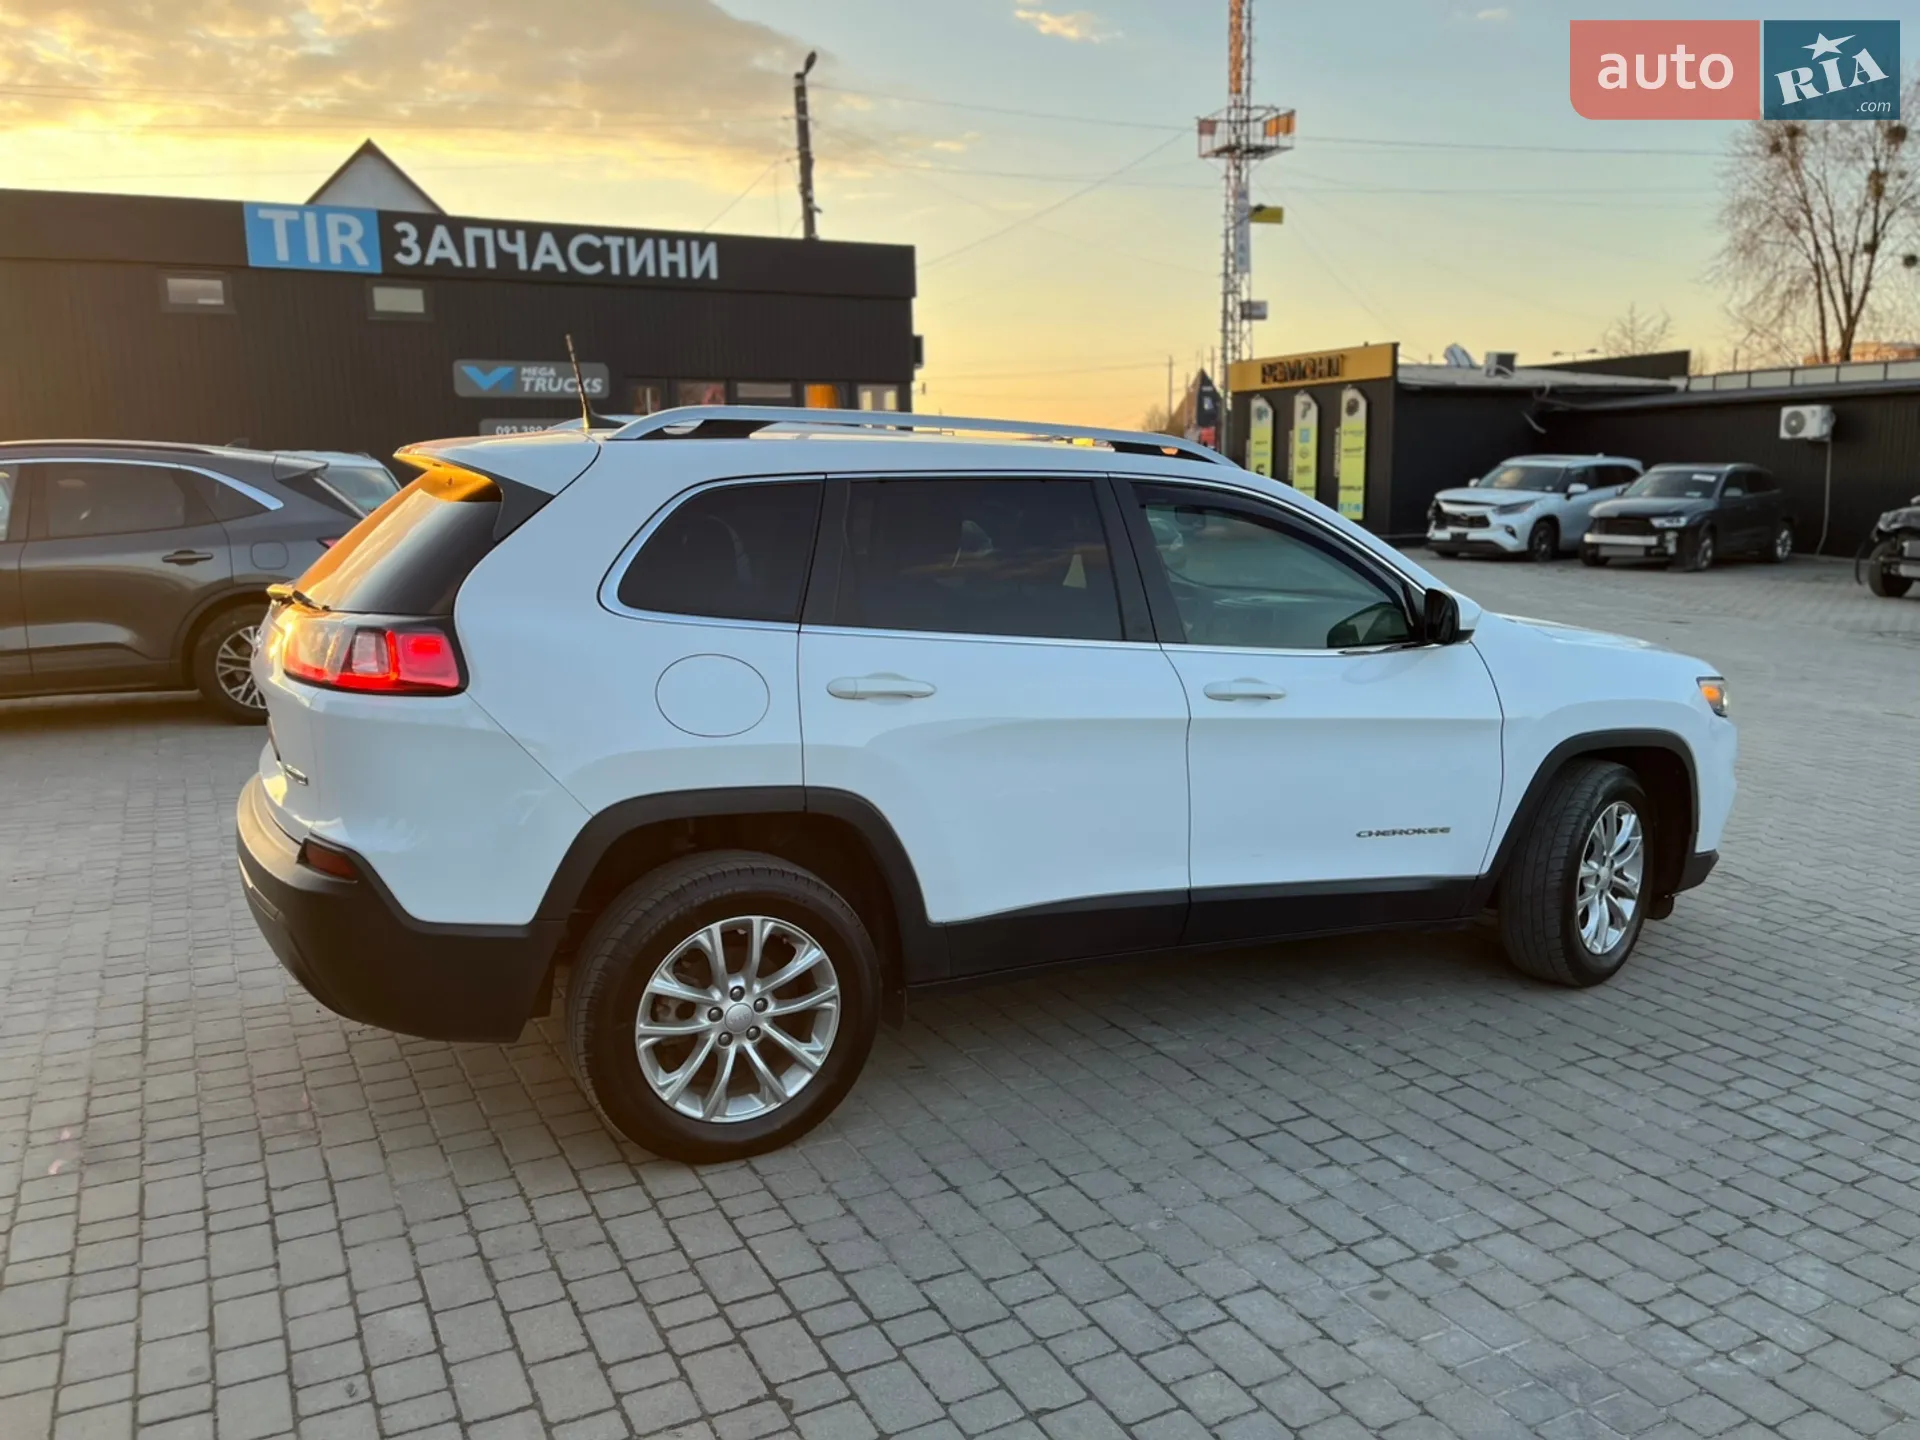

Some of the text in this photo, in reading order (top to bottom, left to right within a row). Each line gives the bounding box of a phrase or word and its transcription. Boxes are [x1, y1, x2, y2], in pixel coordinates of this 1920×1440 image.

[257, 209, 370, 266] TIR
[393, 222, 719, 280] ЗАПЧАСТИНИ
[521, 366, 556, 377] MEGA
[521, 377, 603, 393] TRUCKS
[1355, 827, 1451, 838] CHEROKEE
